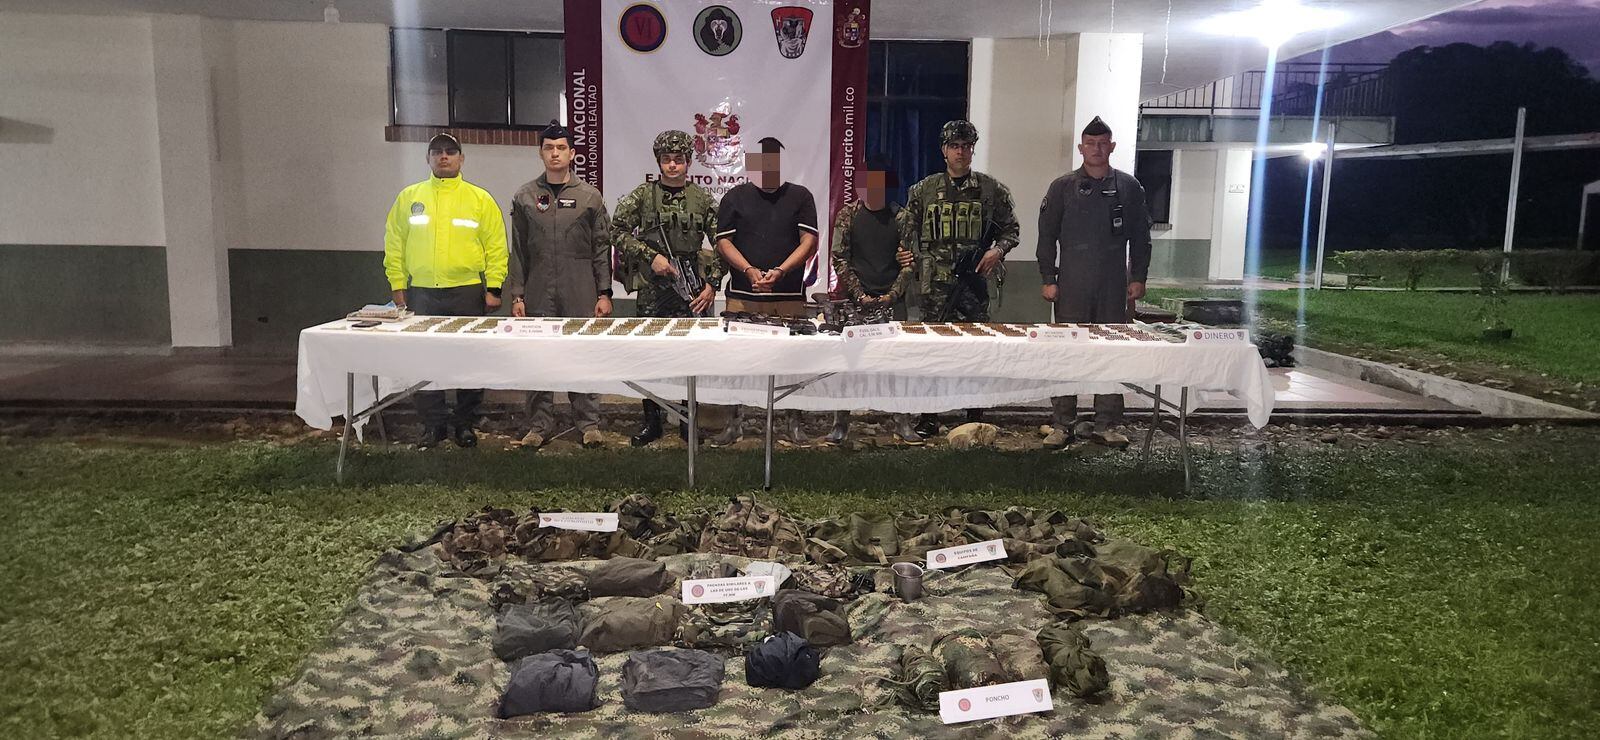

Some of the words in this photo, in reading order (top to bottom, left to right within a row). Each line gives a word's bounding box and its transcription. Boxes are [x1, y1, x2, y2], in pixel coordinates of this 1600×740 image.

[573, 68, 586, 146] NACIONAL
[587, 84, 597, 127] LEALTAD
[588, 129, 598, 168] HONOR
[588, 170, 598, 187] RIA
[1204, 332, 1235, 340] DINERO
[985, 694, 1010, 703] PONCHO
